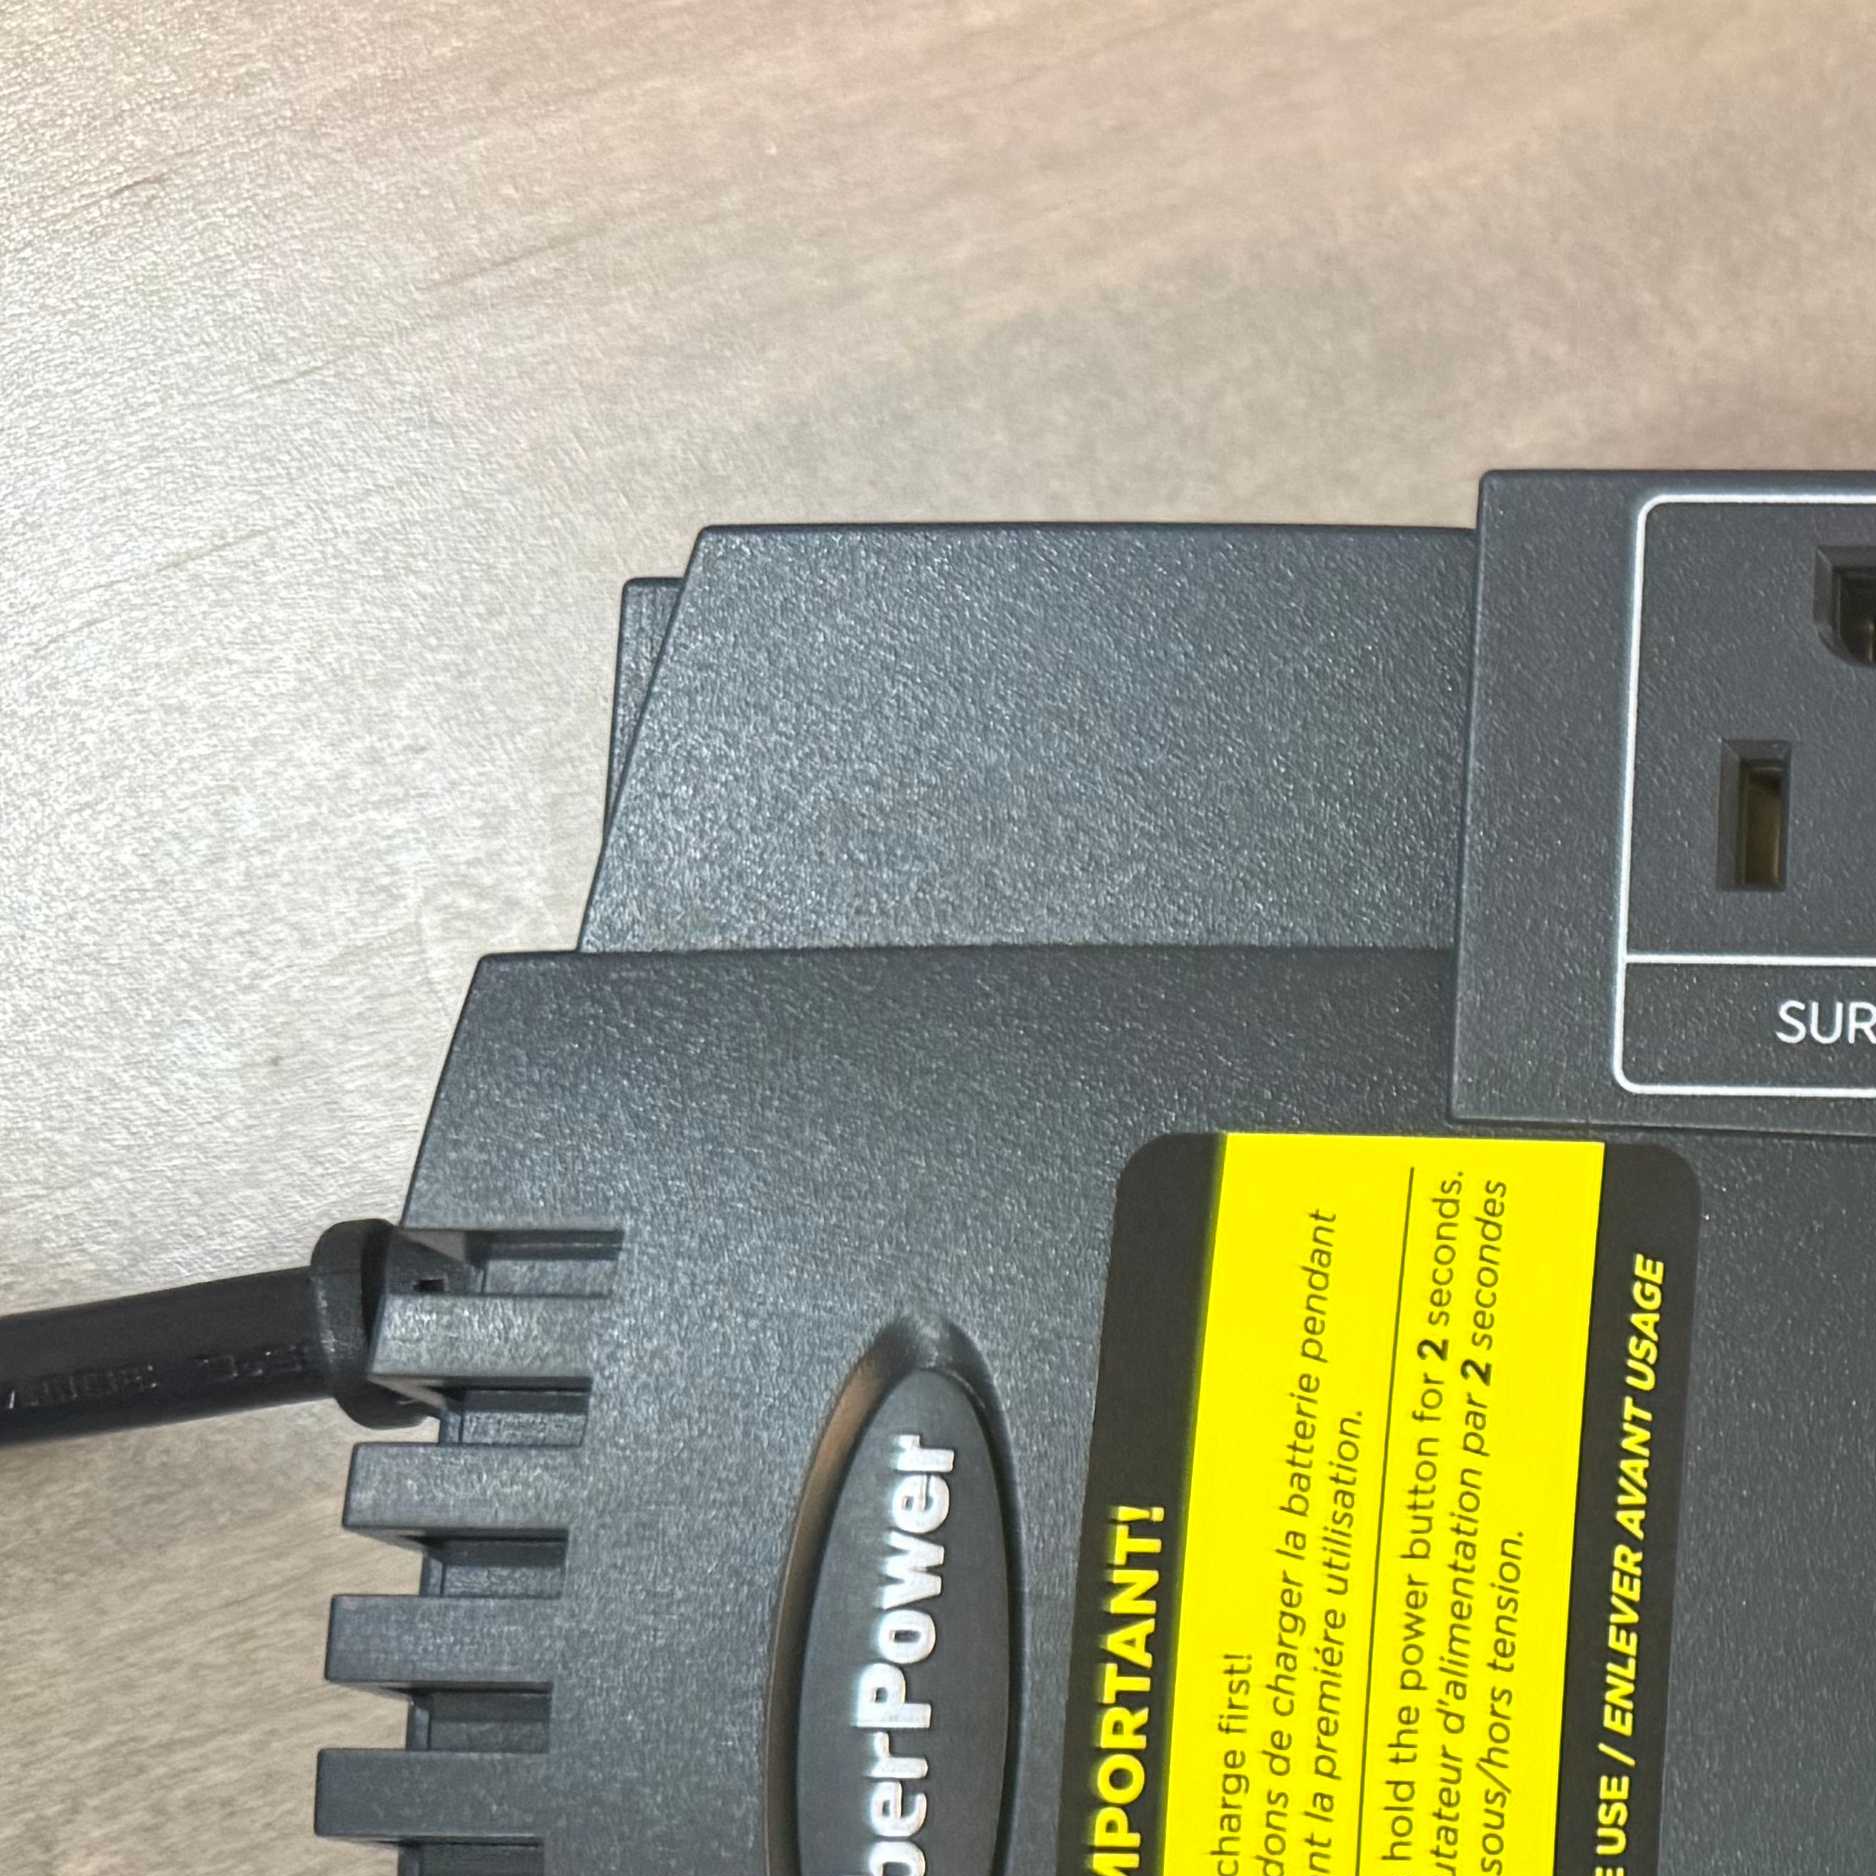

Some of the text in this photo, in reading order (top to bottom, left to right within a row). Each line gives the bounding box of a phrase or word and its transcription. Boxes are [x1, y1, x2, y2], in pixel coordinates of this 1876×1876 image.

[1300, 1209, 1337, 1364] pendant
[1427, 1171, 1464, 1327] seconds.
[1470, 1179, 1508, 1351] secondes
[1415, 1337, 1450, 1362] 2
[1459, 1357, 1493, 1387] 2
[1624, 1252, 1666, 1393] USAGE
[1278, 1372, 1321, 1518] batterie
[1410, 1372, 1444, 1423] for
[1461, 1391, 1491, 1458] par
[1399, 1436, 1440, 1561] button
[1614, 1395, 1654, 1542] AVANT
[1274, 1529, 1307, 1561] la
[1435, 1467, 1483, 1735] d'alimentation
[1486, 1531, 1524, 1674] tension.
[1264, 1569, 1307, 1718] charger
[1303, 1791, 1335, 1823] la
[1321, 1410, 1363, 1596] utilisation.
[1399, 1573, 1429, 1692] power
[1601, 1542, 1645, 1738] ENLEVER
[1216, 1653, 1253, 1736] first!
[1260, 1729, 1293, 1778] de
[1386, 1704, 1421, 1765] the
[1597, 1742, 1637, 1768] /
[1380, 1779, 1416, 1862] hold
[1475, 1686, 1514, 1876] sous/hors
[1594, 1774, 1631, 1857] USE
